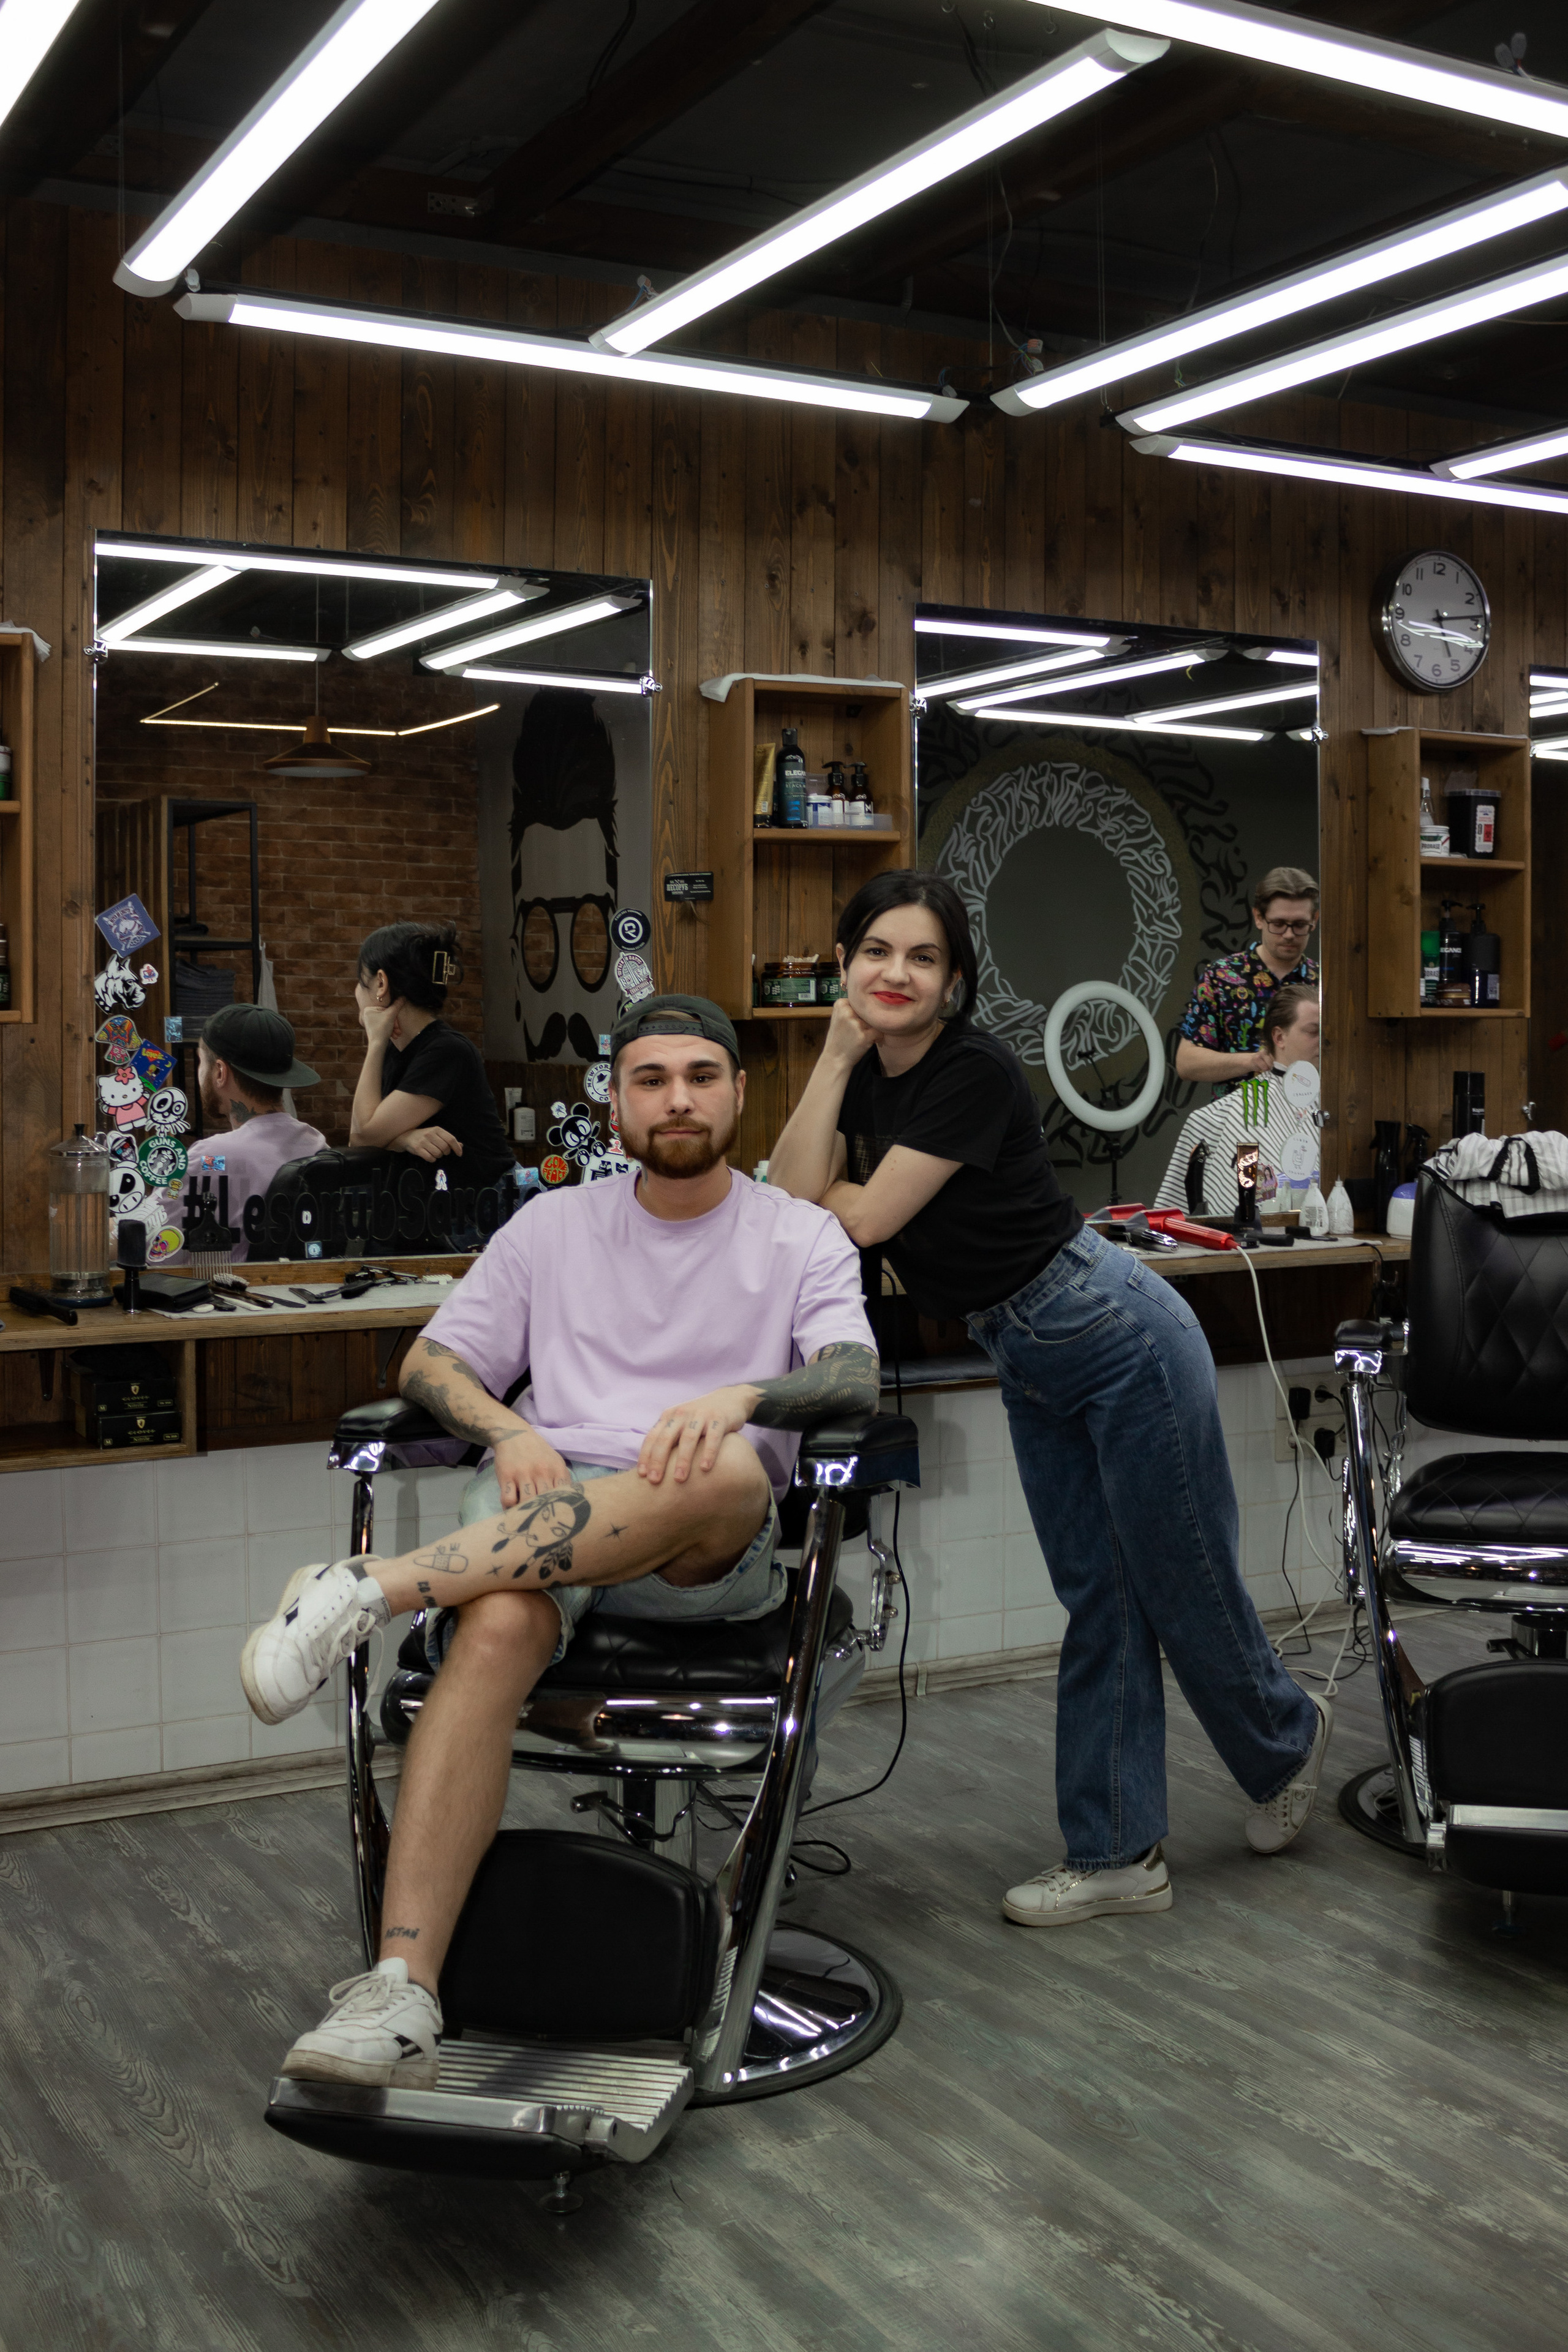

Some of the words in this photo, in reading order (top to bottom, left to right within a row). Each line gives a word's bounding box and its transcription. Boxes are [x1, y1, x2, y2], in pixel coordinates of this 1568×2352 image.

[1415, 567, 1423, 581] 11
[1433, 562, 1446, 576] 12
[1456, 571, 1460, 584] 1
[1402, 583, 1412, 596] 10
[1464, 592, 1475, 605] 2
[1395, 607, 1405, 620] 9
[1400, 634, 1411, 647] 8
[1414, 654, 1423, 668] 7
[1450, 659, 1461, 672] 5
[1431, 664, 1442, 677] 6
[148, 1137, 176, 1148] GUNS
[174, 1147, 186, 1170] AND
[544, 1156, 567, 1170] LOVE
[139, 1160, 168, 1185] COFFEE
[543, 1169, 567, 1183] PEACE
[183, 1167, 543, 1251] #LesorubSarat
